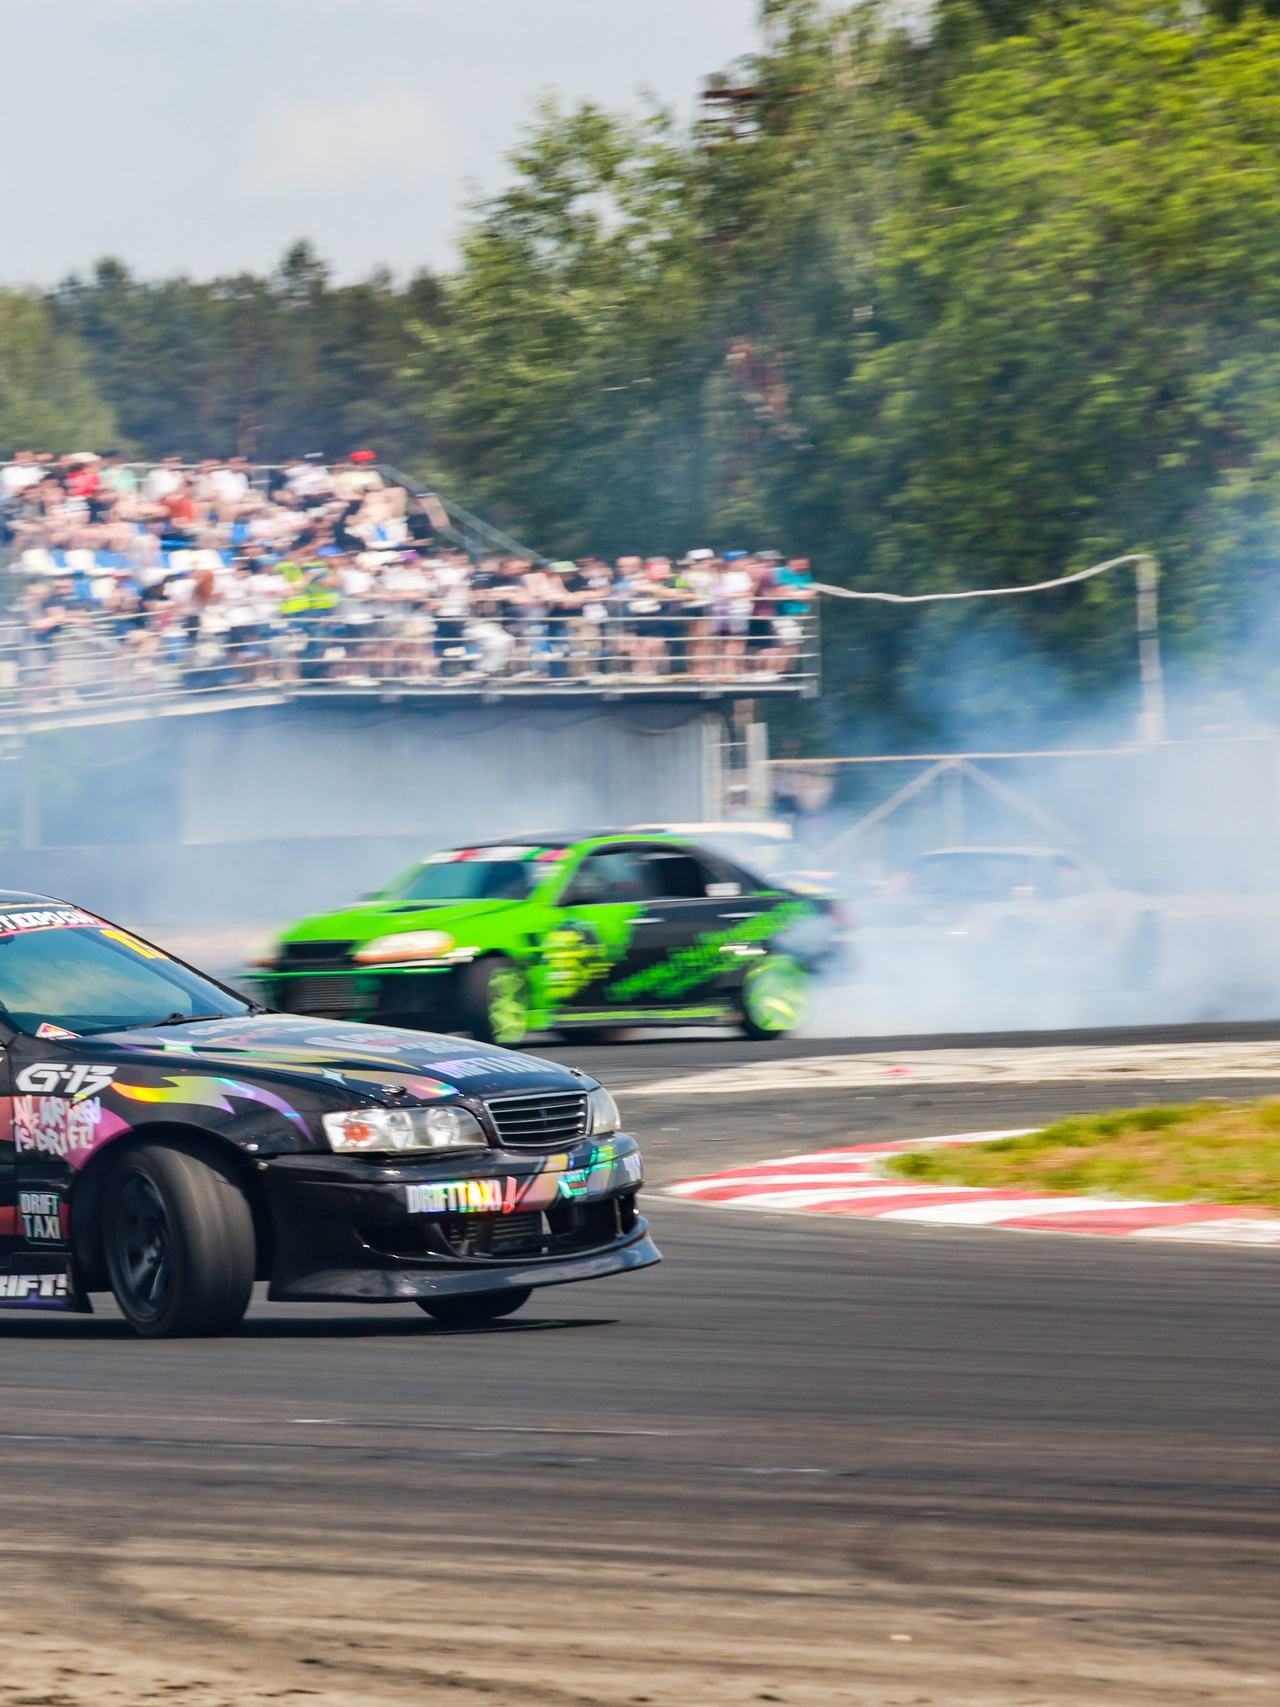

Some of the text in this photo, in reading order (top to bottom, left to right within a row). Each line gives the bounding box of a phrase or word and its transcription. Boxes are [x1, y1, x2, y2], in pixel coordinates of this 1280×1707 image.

[14, 911, 61, 928] EXPO
[20, 1192, 59, 1215] DRIFT
[22, 1215, 62, 1240] TAXI
